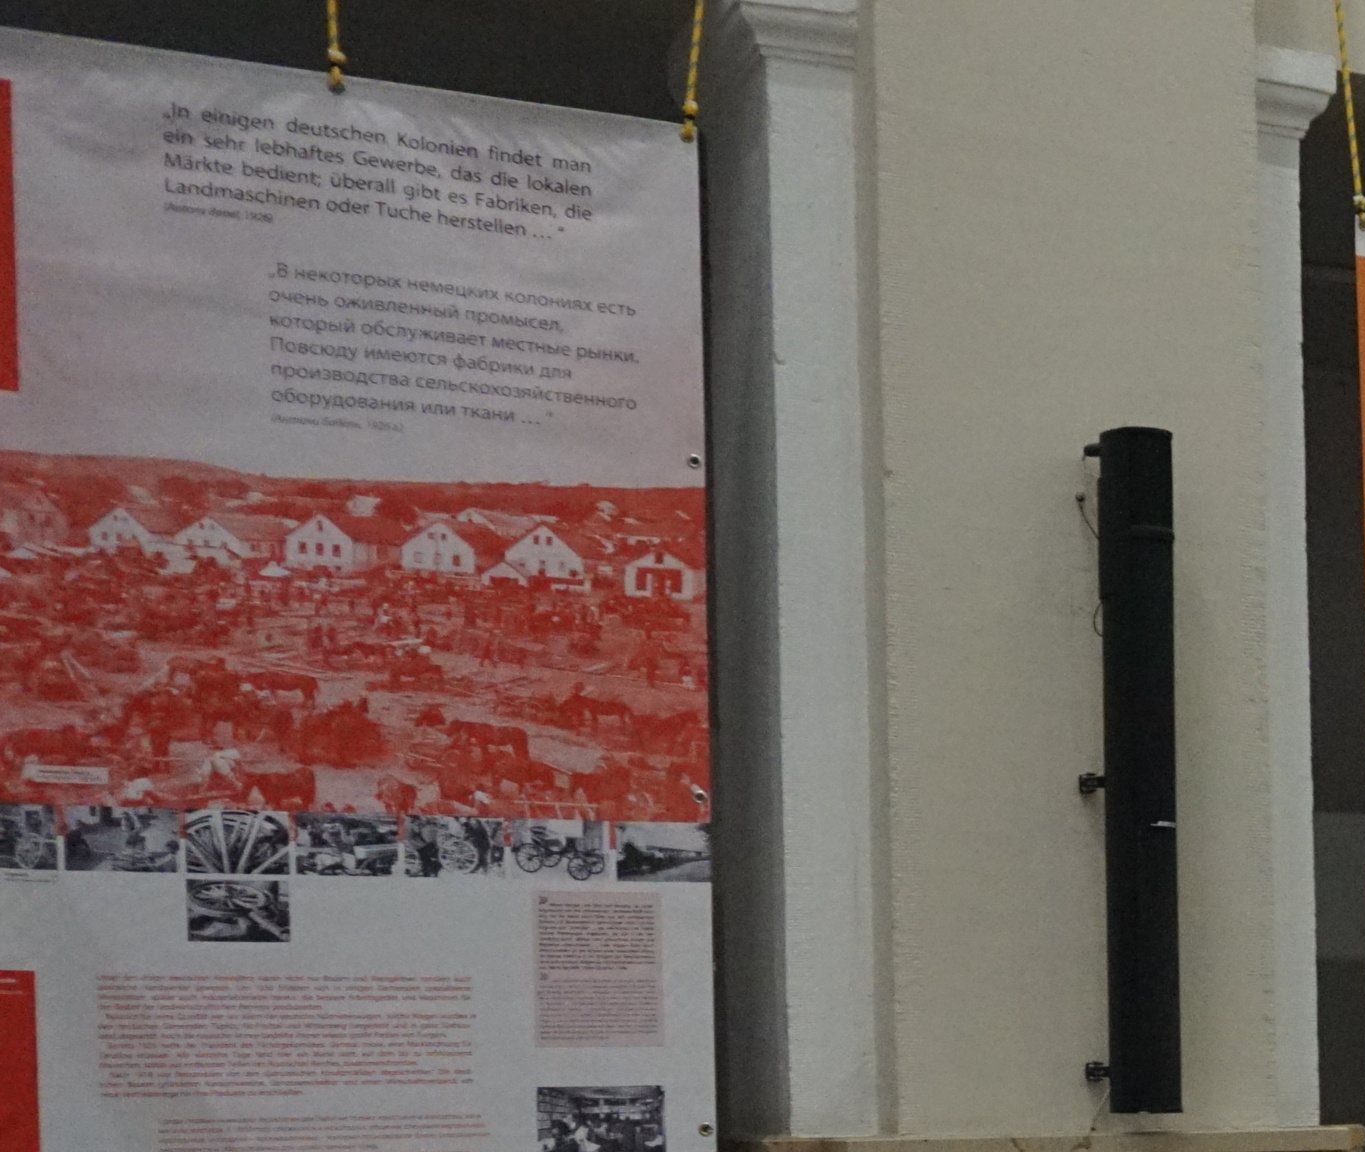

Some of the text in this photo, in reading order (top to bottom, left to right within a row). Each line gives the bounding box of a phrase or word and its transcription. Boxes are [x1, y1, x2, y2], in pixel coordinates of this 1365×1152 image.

[163, 129, 591, 197] ein sehr lebhaftes Gewerbe, das die lokalen
[202, 109, 274, 133] einigen
[287, 118, 385, 146] deutschen
[398, 133, 478, 158] Kolonien
[489, 145, 542, 167] findet
[553, 157, 591, 173] man
[164, 152, 232, 175] Märkte
[331, 173, 394, 196] überall
[404, 184, 440, 203] gibt
[448, 191, 467, 205] es
[475, 191, 557, 219] Fabriken,
[565, 202, 592, 221] die
[165, 178, 526, 236] Landmaschinen oder Tuche herstellen
[269, 291, 328, 307] очень
[334, 297, 458, 319] оживленный
[294, 268, 401, 291] некоторых
[407, 279, 498, 300] немецких
[505, 290, 592, 312] колониях
[597, 302, 636, 317] есть
[270, 315, 355, 335] который
[361, 321, 486, 347] обслуживает
[492, 337, 571, 357] местные
[270, 337, 572, 379] Повсюду имеются фабрики для
[271, 364, 637, 411] производства сельскохозяйственного
[271, 389, 515, 423] оборудования или ткани
